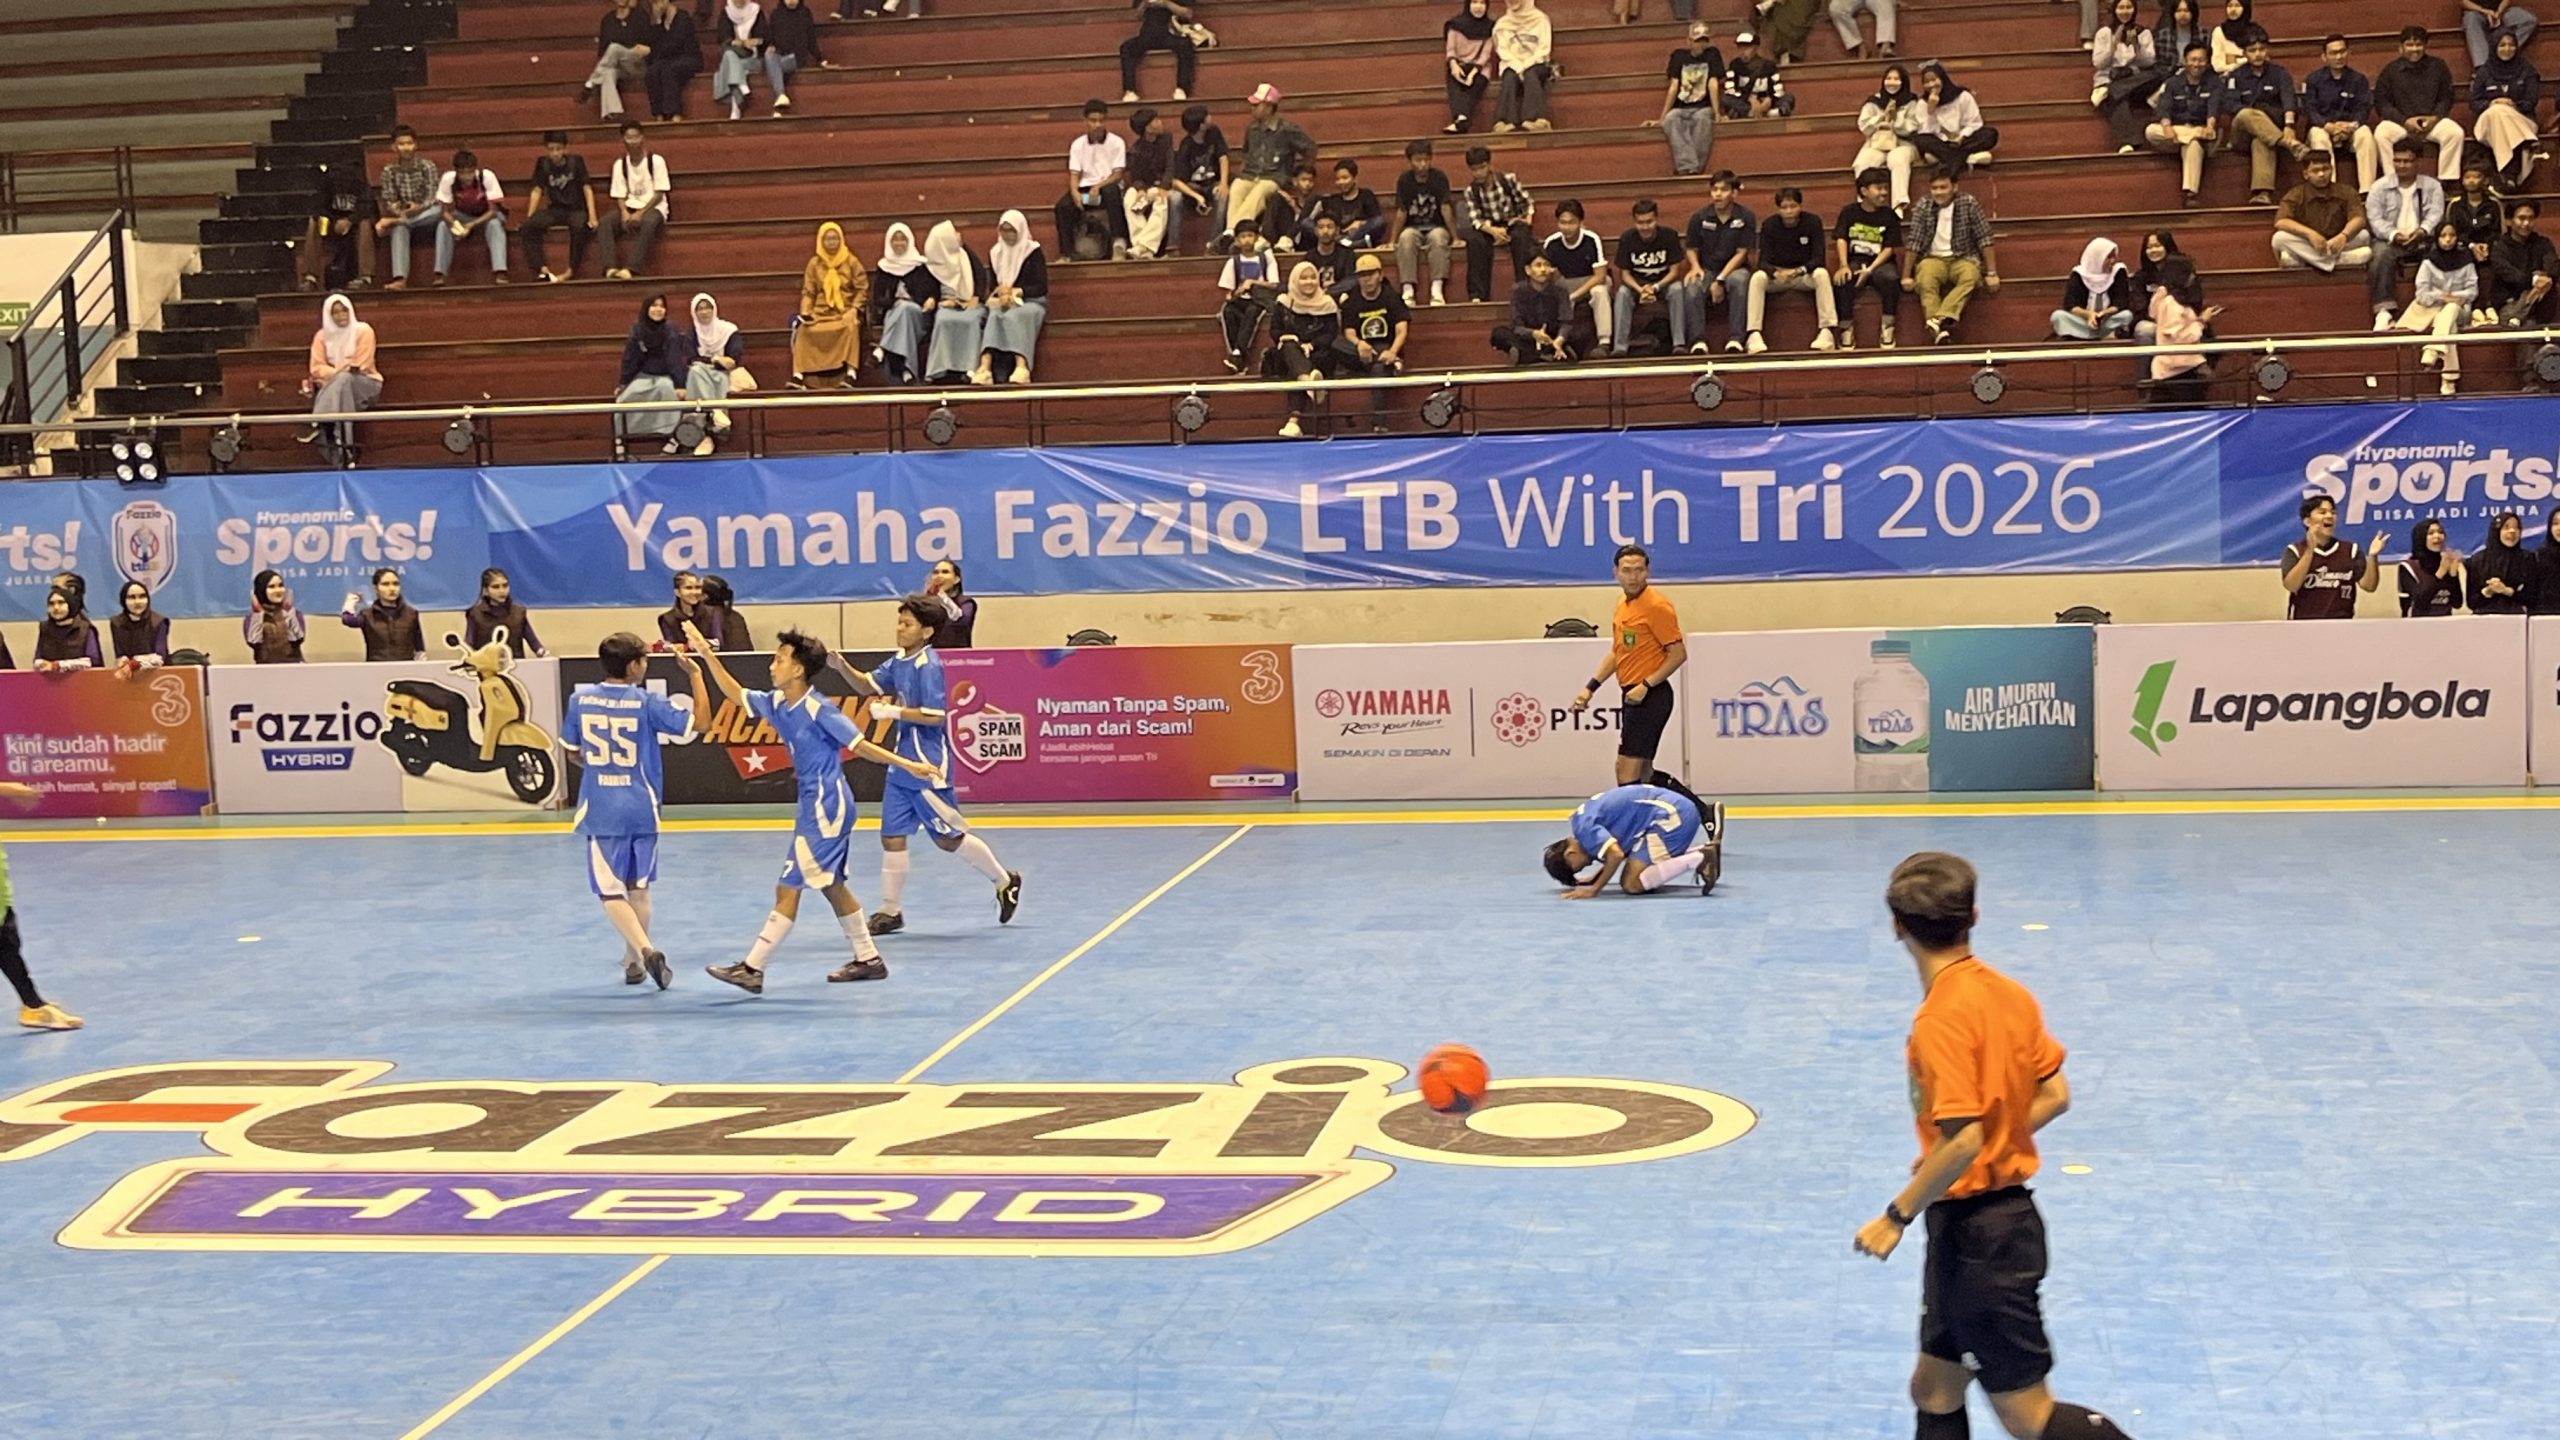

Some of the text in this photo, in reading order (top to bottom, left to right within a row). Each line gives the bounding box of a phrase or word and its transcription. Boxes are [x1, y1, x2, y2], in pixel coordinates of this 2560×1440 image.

[0, 308, 29, 321] XIT
[605, 458, 2101, 572] Yamaha Fazzio LTB With Tri 2026
[2373, 510, 2414, 521] BISA
[2426, 507, 2468, 519] JADI
[0, 520, 81, 572] ts!
[215, 510, 438, 577] Sports!
[1037, 695, 1231, 717] Nyaman Tanpa Spam,
[1346, 689, 1452, 716] YAMAHA
[1964, 682, 2056, 713] AIR MURNI
[2189, 680, 2491, 731] Lapangbola
[230, 701, 382, 743] Fazzio
[978, 721, 1021, 736] SPAM
[1039, 718, 1194, 737] Aman dari Scam!
[1711, 697, 1828, 738] TRAS
[1945, 698, 2076, 732] MENYEHATKAN
[5, 733, 168, 755] kini sudah hadir
[581, 713, 638, 767] 55
[979, 743, 1022, 757] SCAM
[1323, 749, 1386, 758] SEMAKIN
[7, 756, 116, 775] di areamu.
[271, 753, 346, 767] HYBRID
[0, 1065, 1714, 1158] Fazzio
[237, 1187, 1167, 1223] HYBRID
